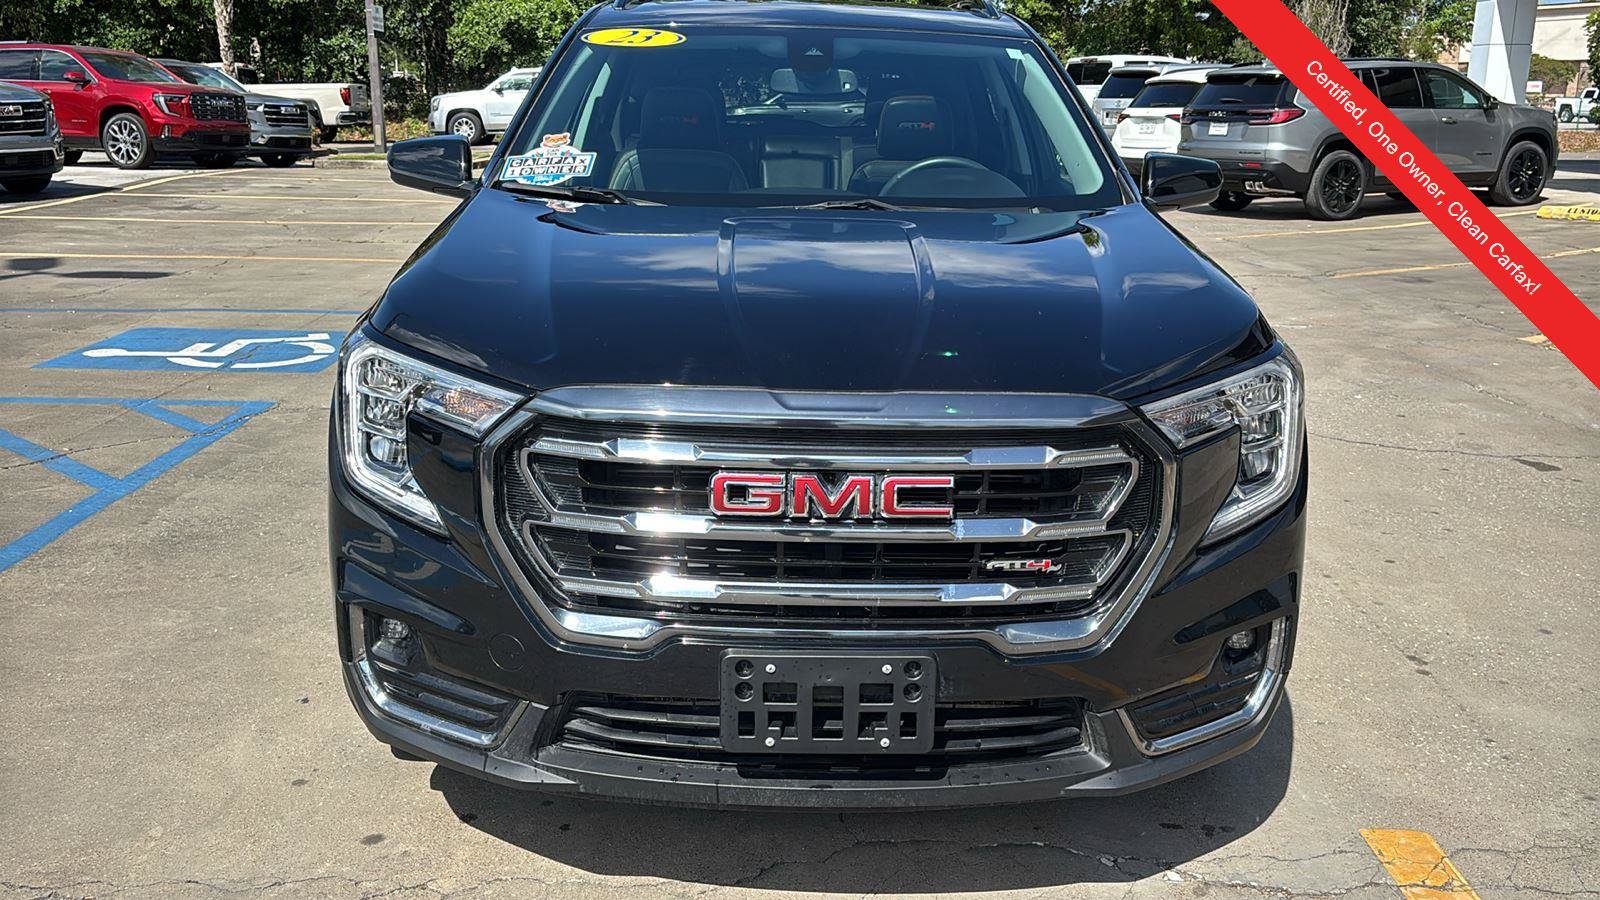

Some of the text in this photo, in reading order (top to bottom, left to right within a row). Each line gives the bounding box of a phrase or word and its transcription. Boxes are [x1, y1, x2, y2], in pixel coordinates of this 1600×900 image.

[605, 30, 662, 44] 23
[510, 156, 588, 168] CARFAX
[521, 164, 586, 176] OWNER
[1567, 207, 1600, 215] CUSTO
[709, 472, 954, 518] GMC
[986, 559, 1054, 572] AT4
